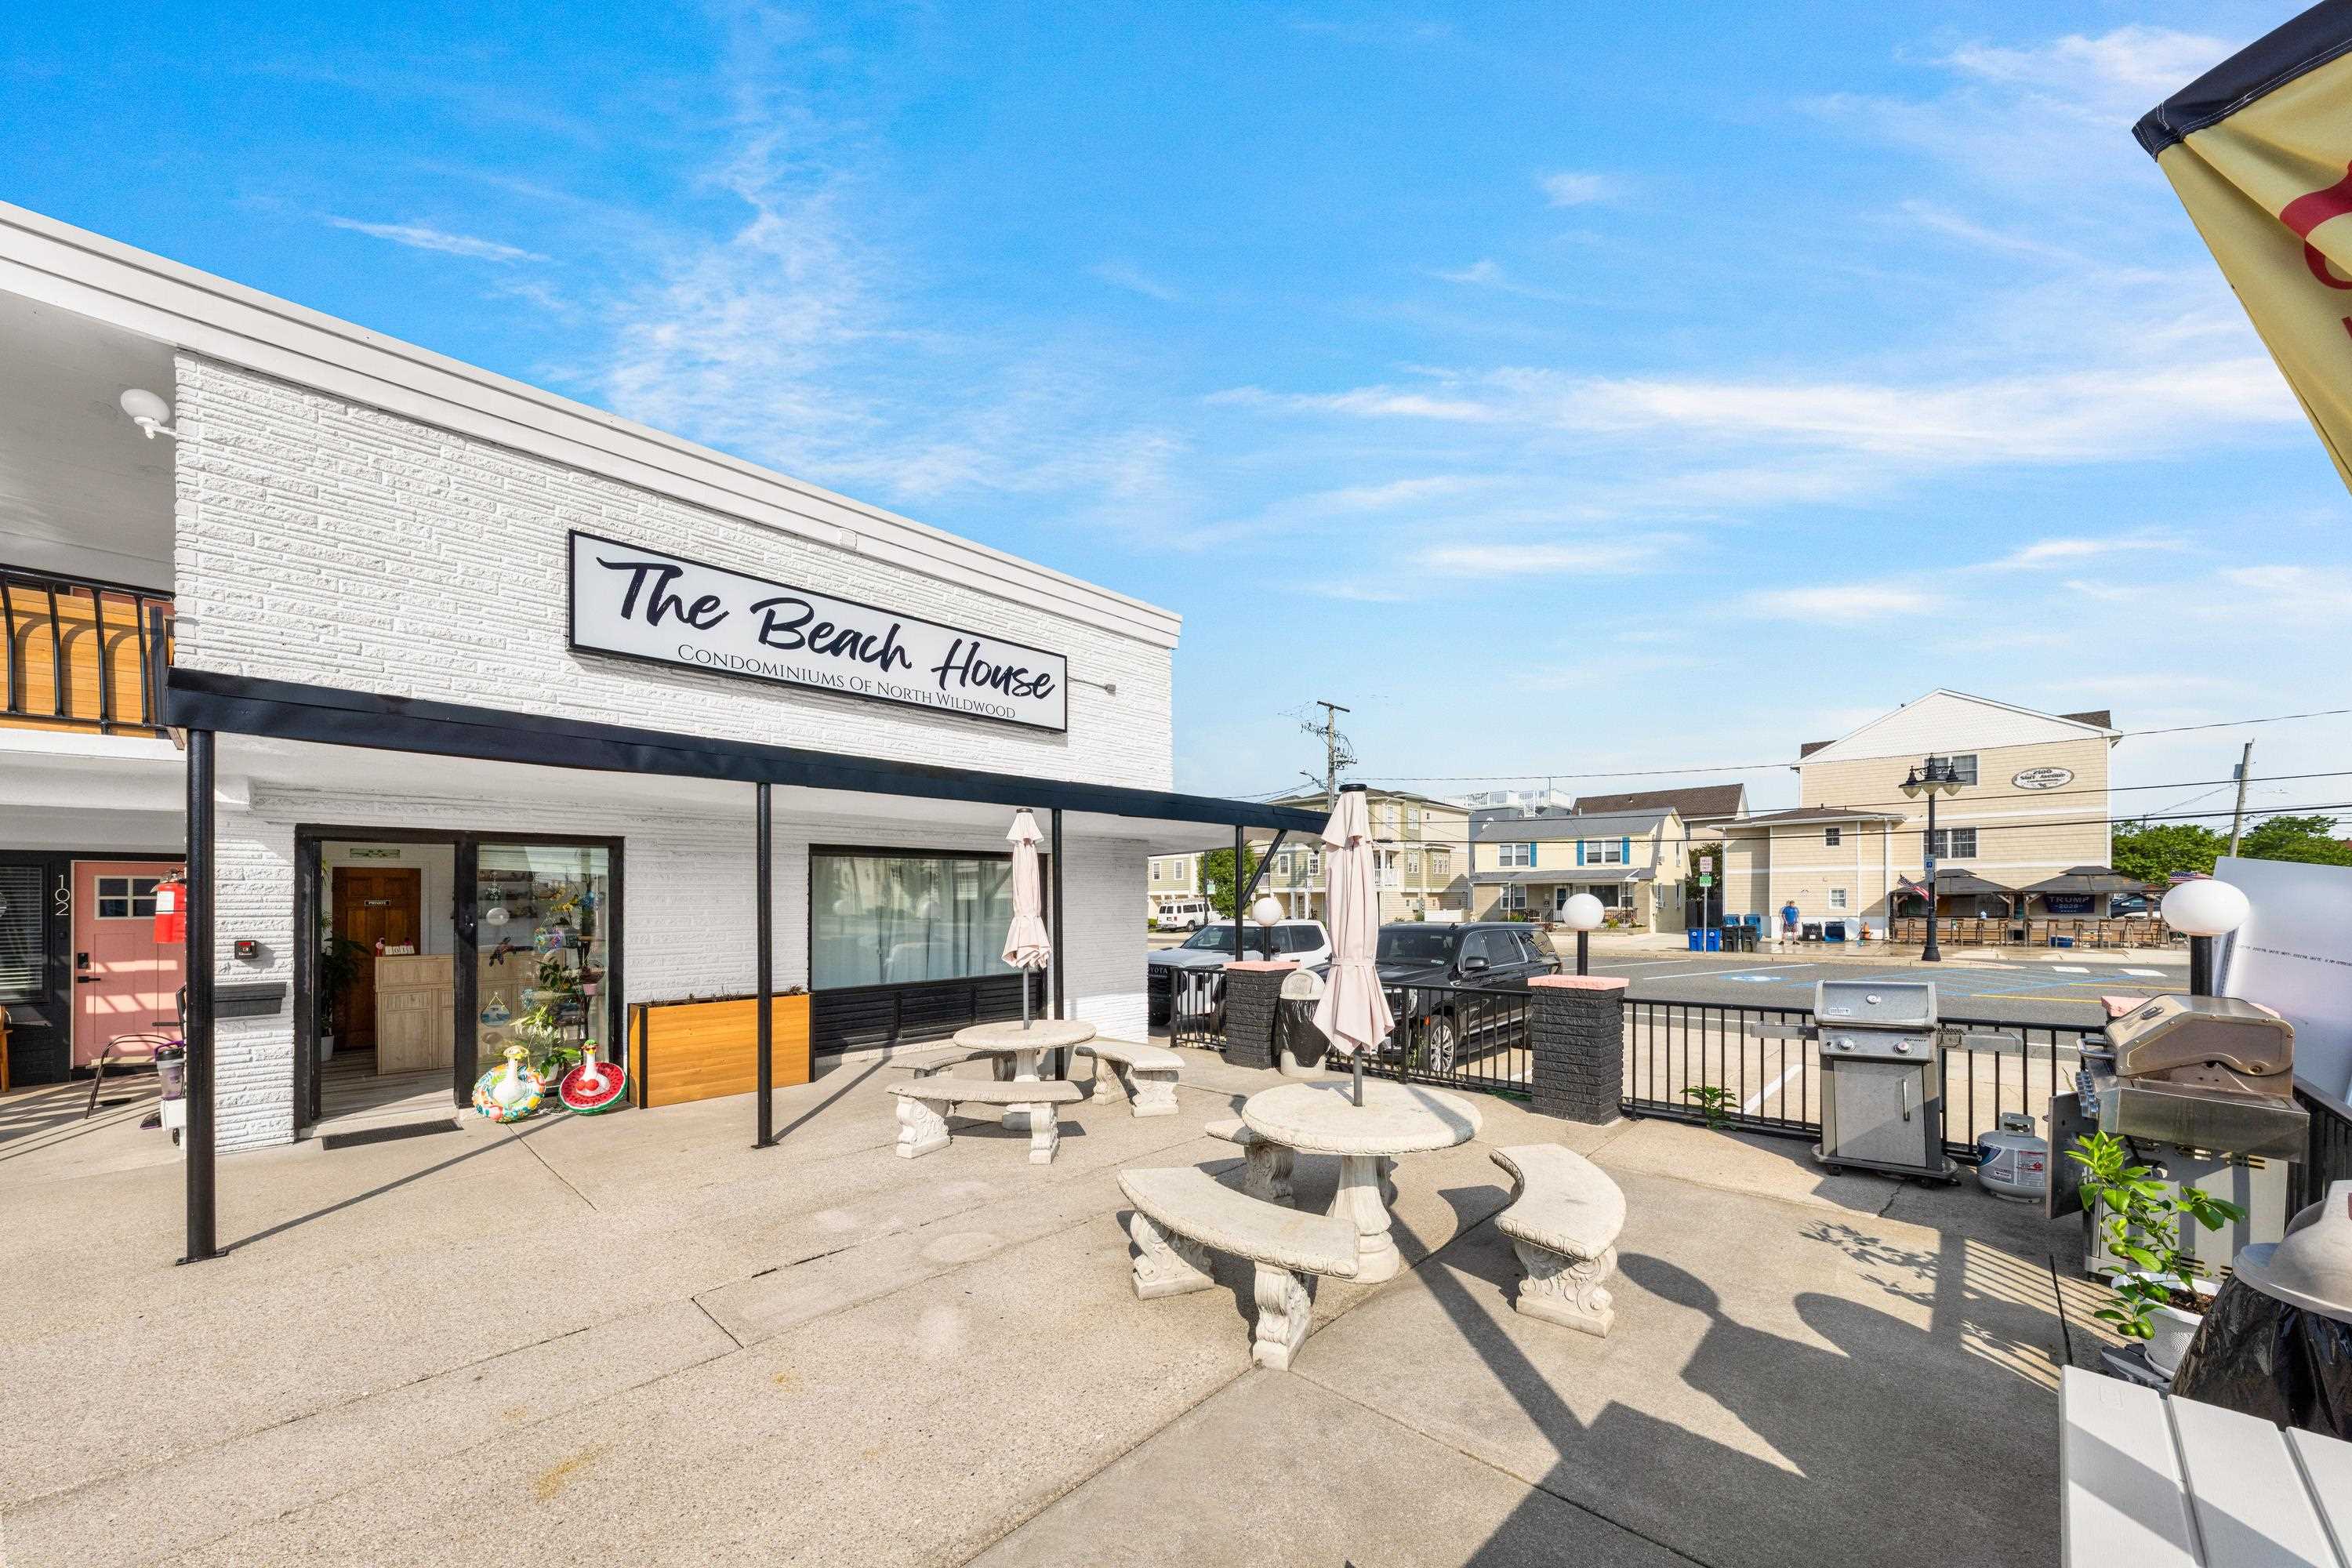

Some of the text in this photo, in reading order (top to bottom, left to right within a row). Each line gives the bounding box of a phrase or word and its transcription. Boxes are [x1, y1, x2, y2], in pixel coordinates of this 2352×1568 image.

[596, 557, 1056, 699] The Beach House
[677, 644, 844, 688] CONDOMINIUMS
[877, 682, 931, 703] NORTH
[936, 691, 1015, 718] WILDWOOD
[55, 874, 71, 916] 102
[1149, 965, 1167, 974] YOTA
